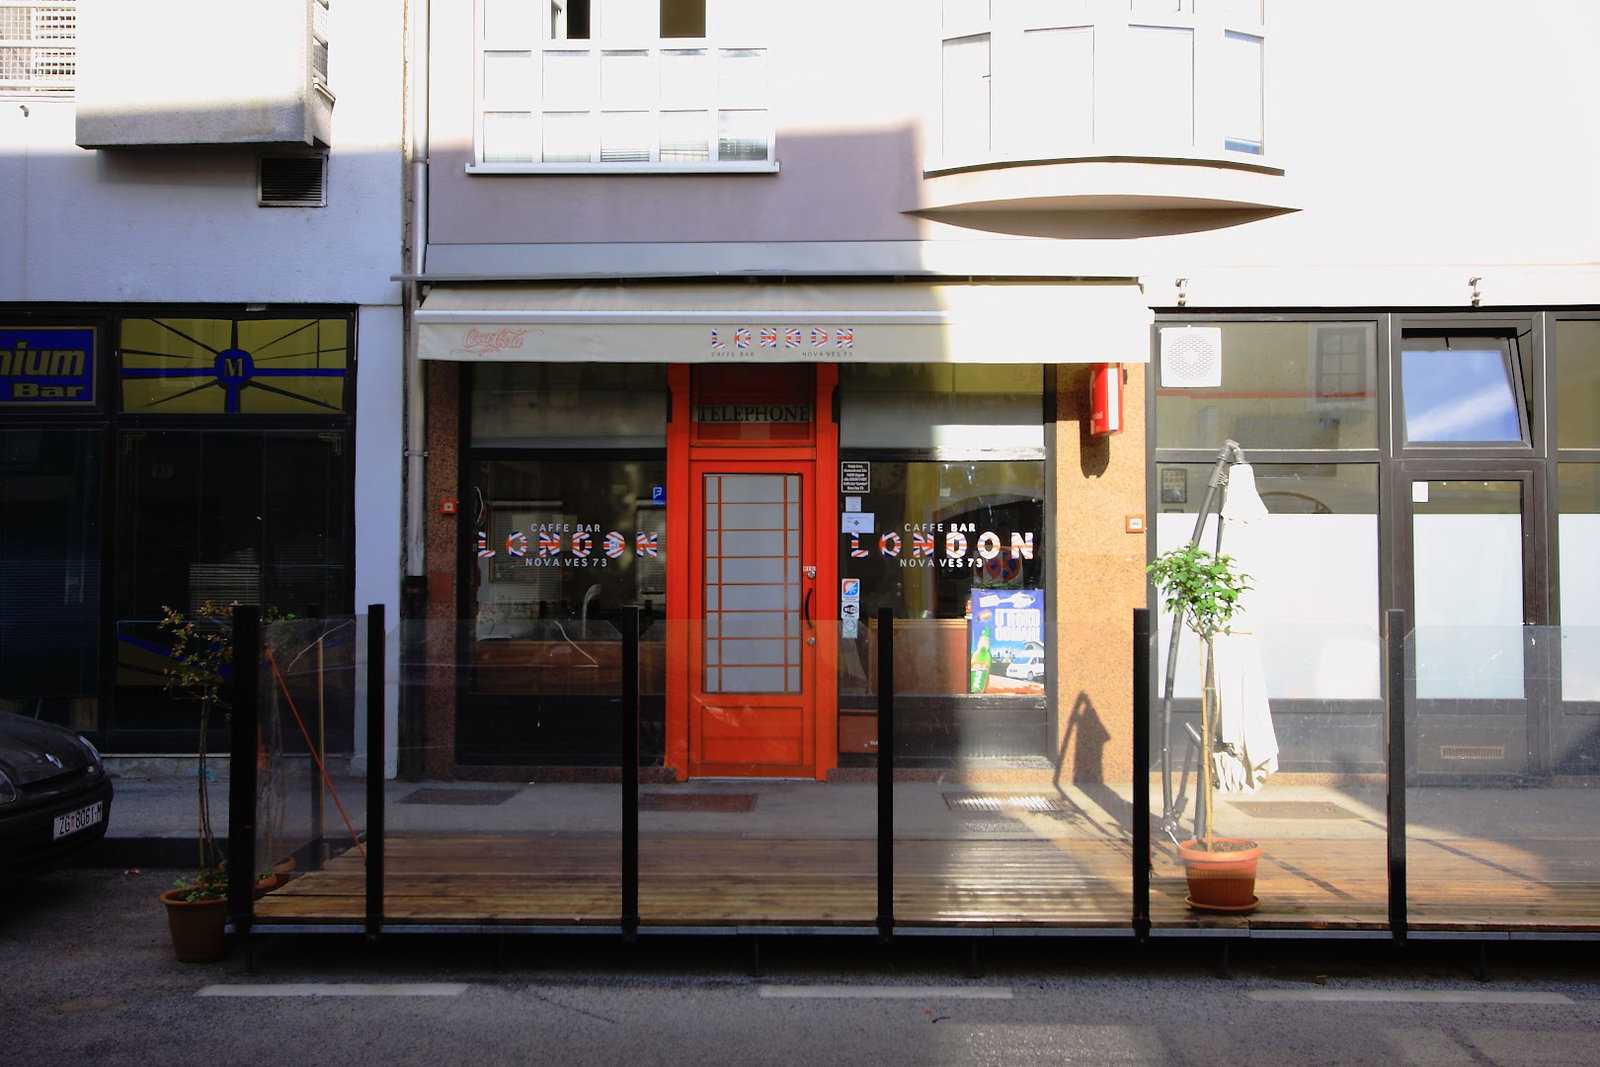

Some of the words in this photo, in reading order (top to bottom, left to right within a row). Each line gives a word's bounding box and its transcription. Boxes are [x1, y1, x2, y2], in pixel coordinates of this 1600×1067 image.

[711, 327, 854, 349] LONDON
[224, 358, 243, 377] M
[13, 383, 84, 397] Bar
[696, 405, 810, 422] TELEPHONE
[530, 523, 570, 533] CAFFE
[576, 523, 601, 533] BAR
[904, 523, 944, 533] CAFFE
[950, 523, 976, 533] BAR
[477, 531, 658, 559] LONDON
[850, 531, 1034, 560] LONDON
[525, 558, 560, 567] NOVA
[565, 558, 588, 567] VES
[592, 558, 608, 567] 73
[900, 558, 935, 568] NOVA
[939, 558, 964, 568] VES
[967, 558, 984, 568] 73
[60, 815, 70, 834] ZG
